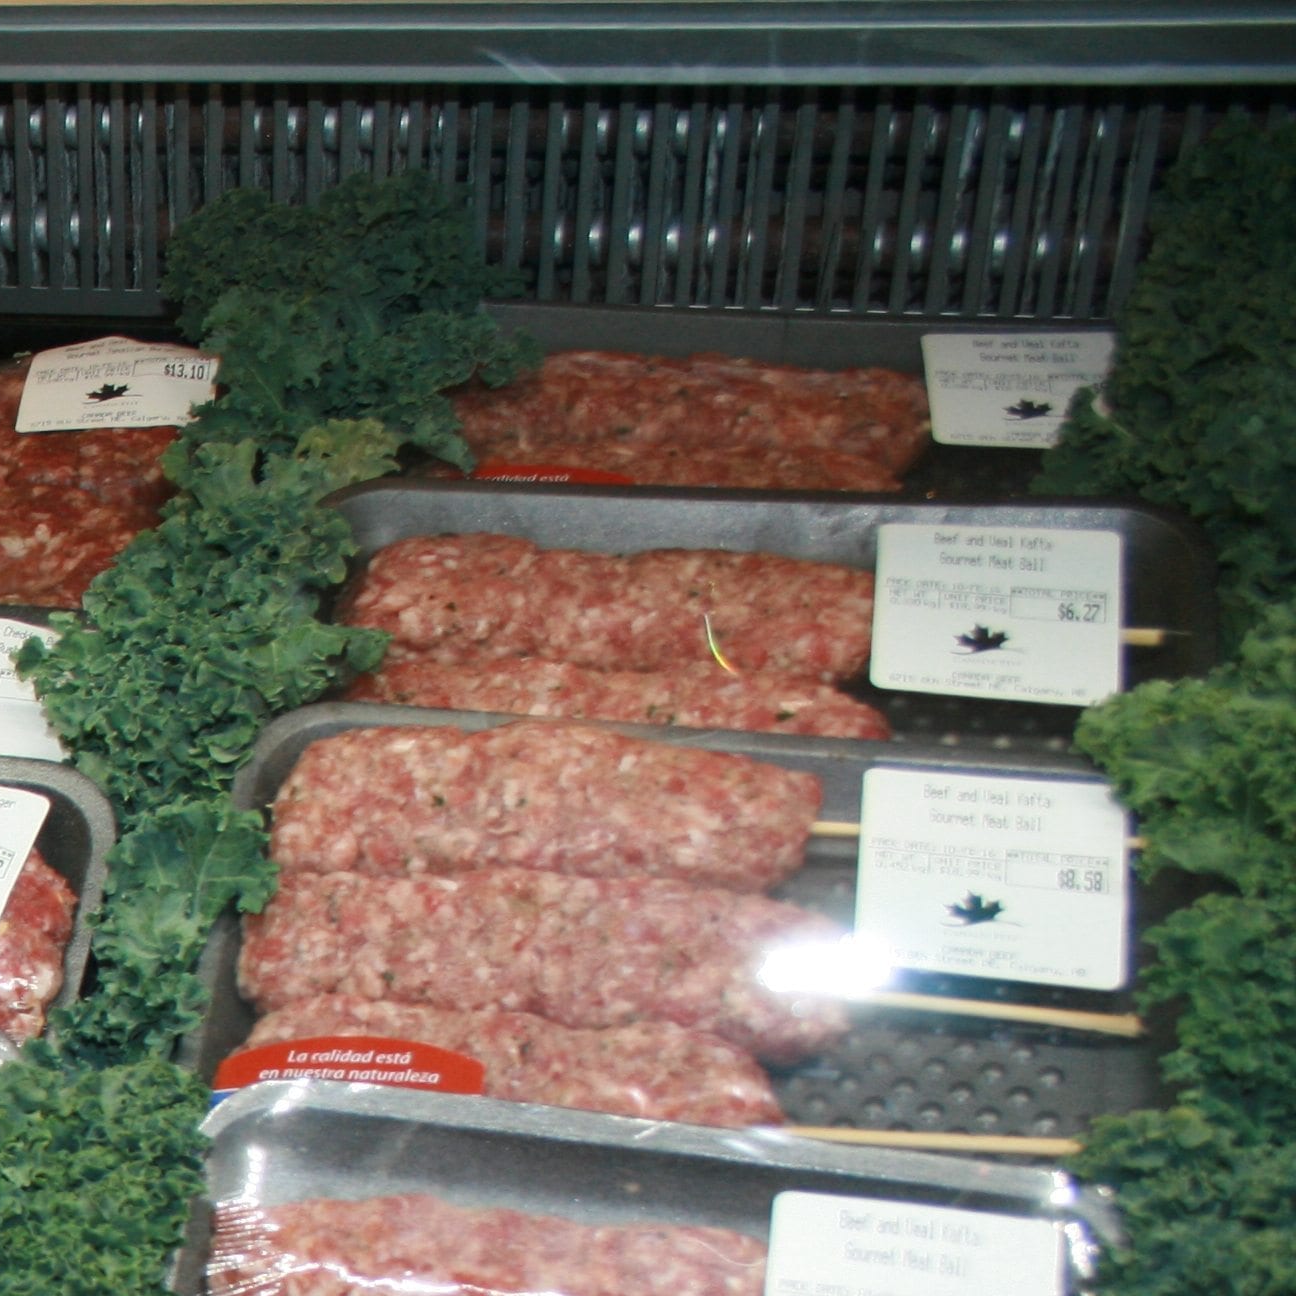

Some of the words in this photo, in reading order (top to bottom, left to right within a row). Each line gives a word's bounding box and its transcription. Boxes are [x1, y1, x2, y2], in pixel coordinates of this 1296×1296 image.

[164, 364, 204, 379] $13.10
[1058, 604, 1100, 622] $6.27
[1057, 870, 1104, 892] $8.58
[288, 1050, 308, 1063] La
[312, 1050, 374, 1064] calidad
[376, 1051, 412, 1064] está
[259, 1068, 278, 1079] en
[283, 1068, 344, 1080] nuestra
[348, 1069, 440, 1084] naturaleza
